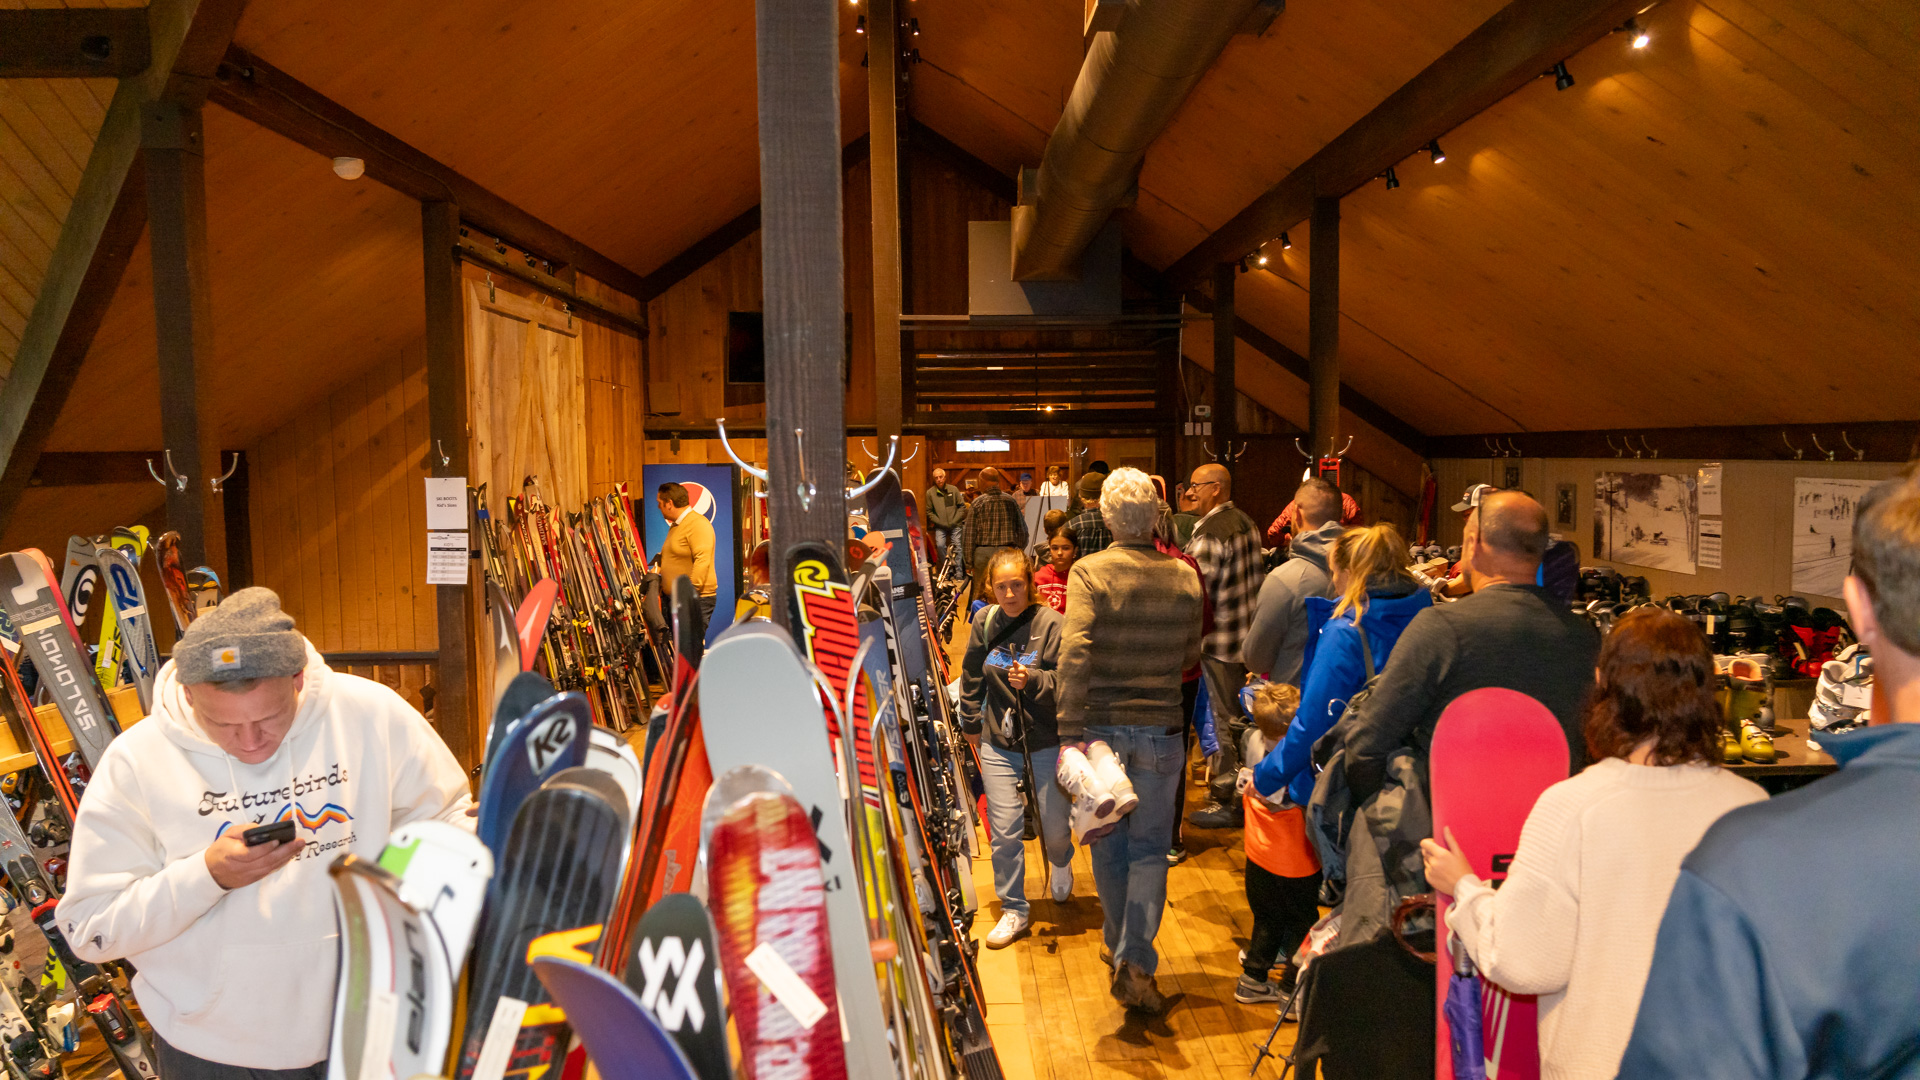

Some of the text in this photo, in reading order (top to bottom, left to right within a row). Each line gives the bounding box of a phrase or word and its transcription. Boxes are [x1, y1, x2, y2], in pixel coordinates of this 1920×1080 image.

[37, 628, 98, 731] SALOMON
[533, 717, 571, 771] K2
[198, 762, 348, 816] Futurebirds
[305, 831, 358, 859] Research
